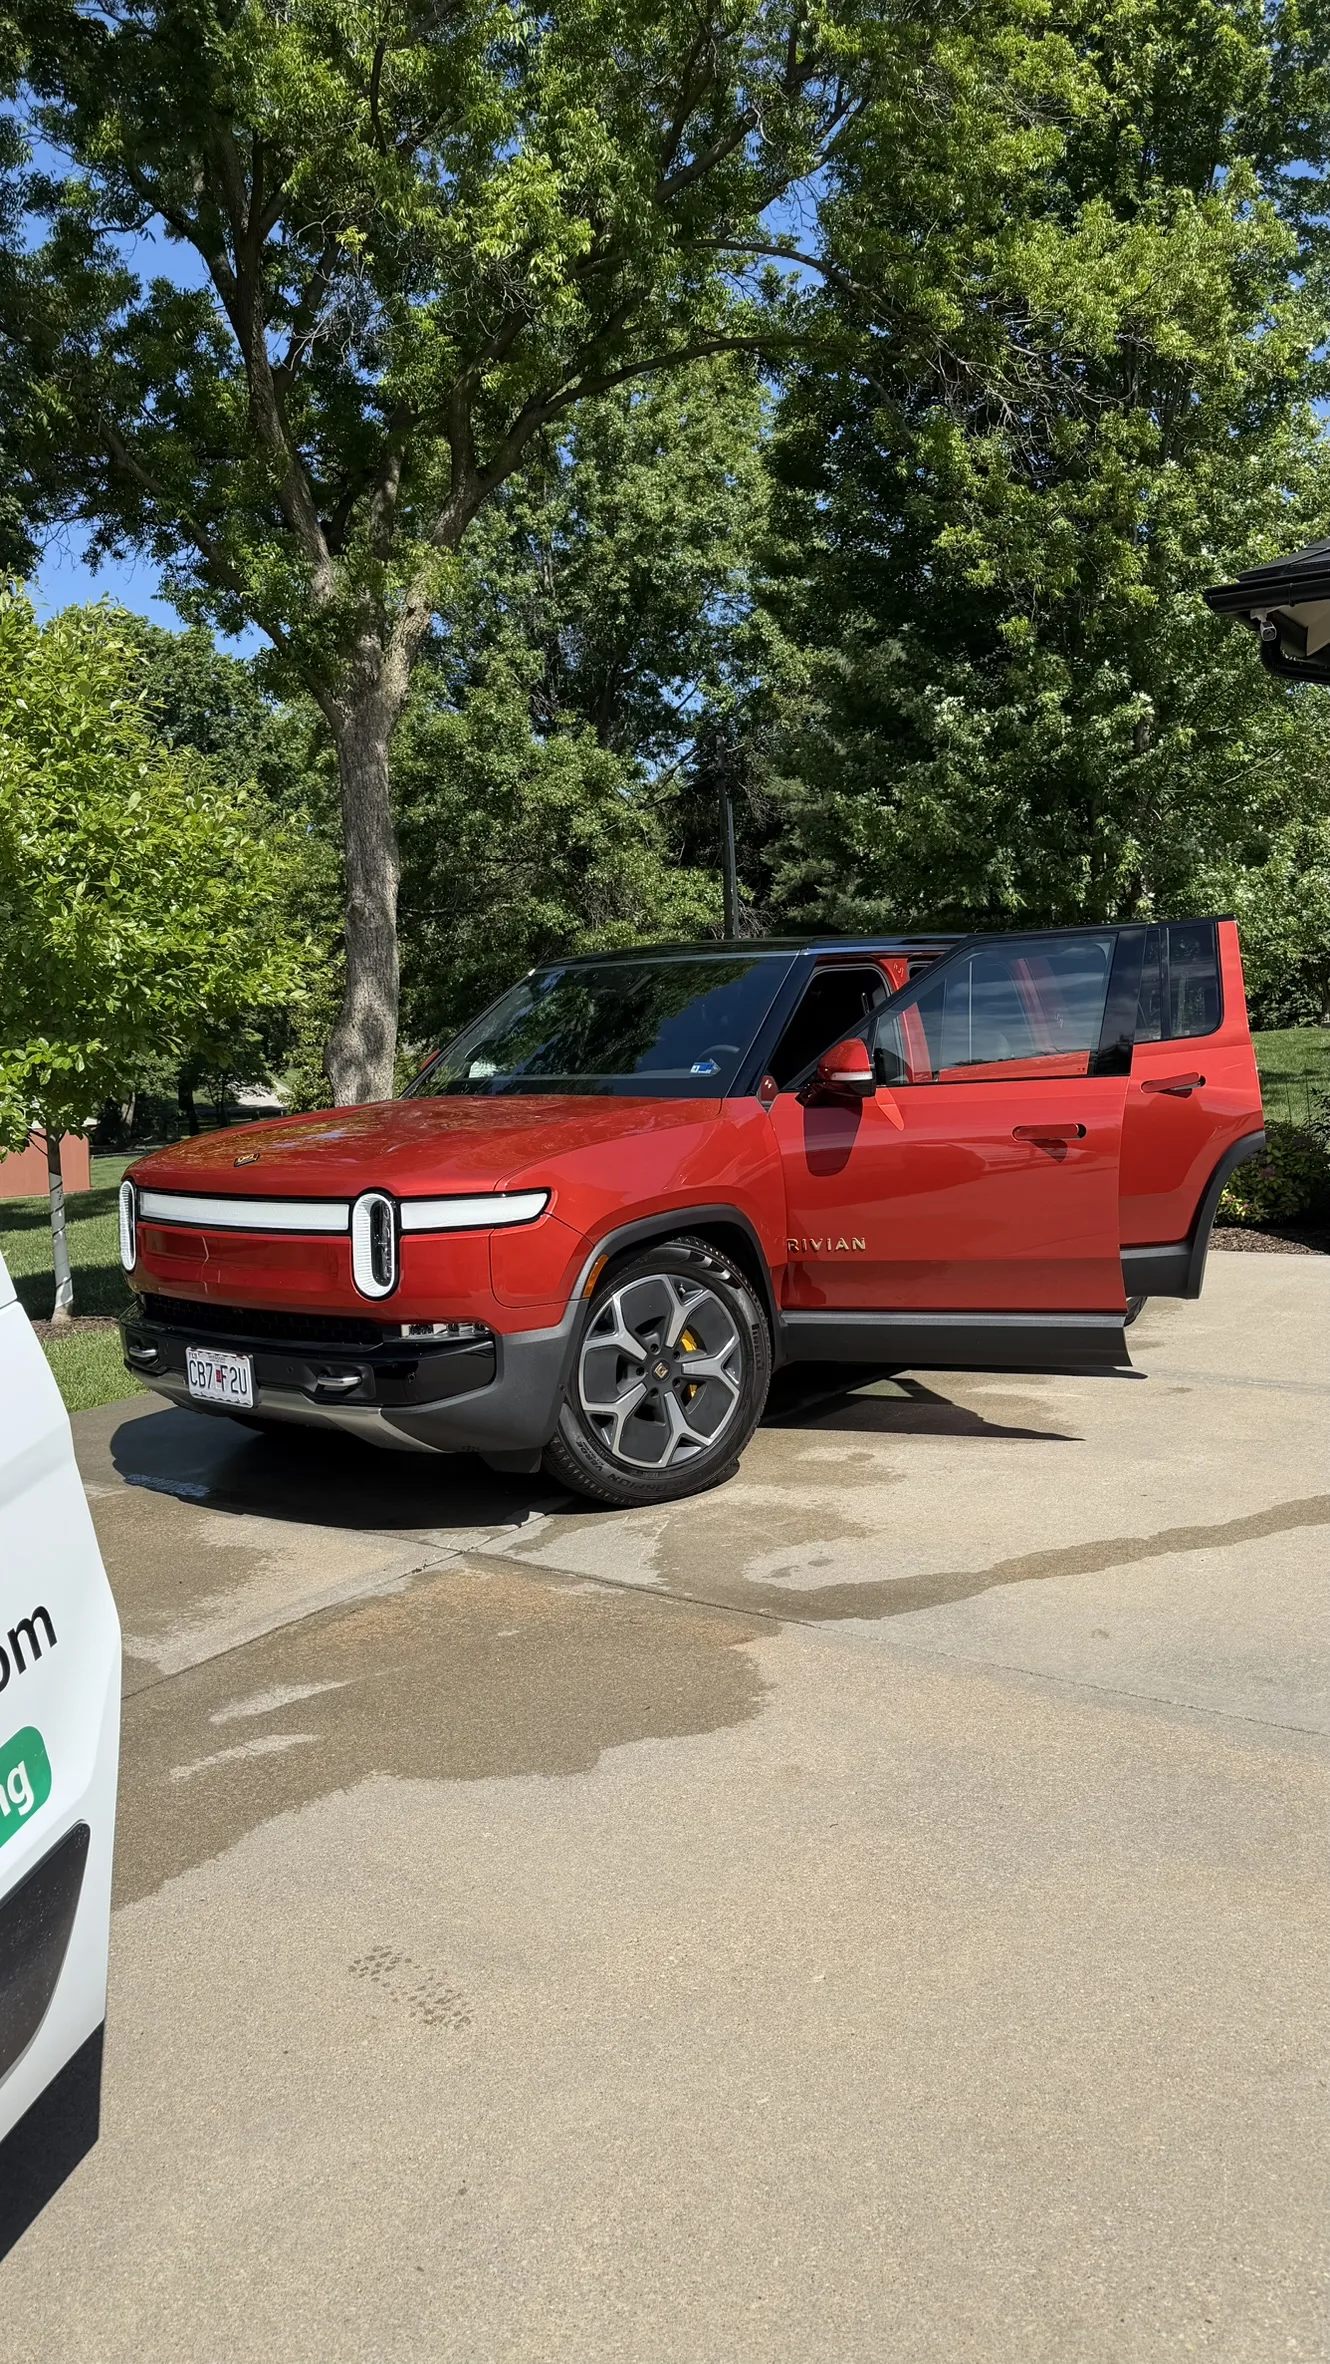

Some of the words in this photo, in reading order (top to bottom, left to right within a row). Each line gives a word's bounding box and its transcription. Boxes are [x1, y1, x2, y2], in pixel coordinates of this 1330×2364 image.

[786, 1237, 866, 1252] RIVIAN
[189, 1360, 213, 1389] CB7
[220, 1365, 247, 1394] F2U
